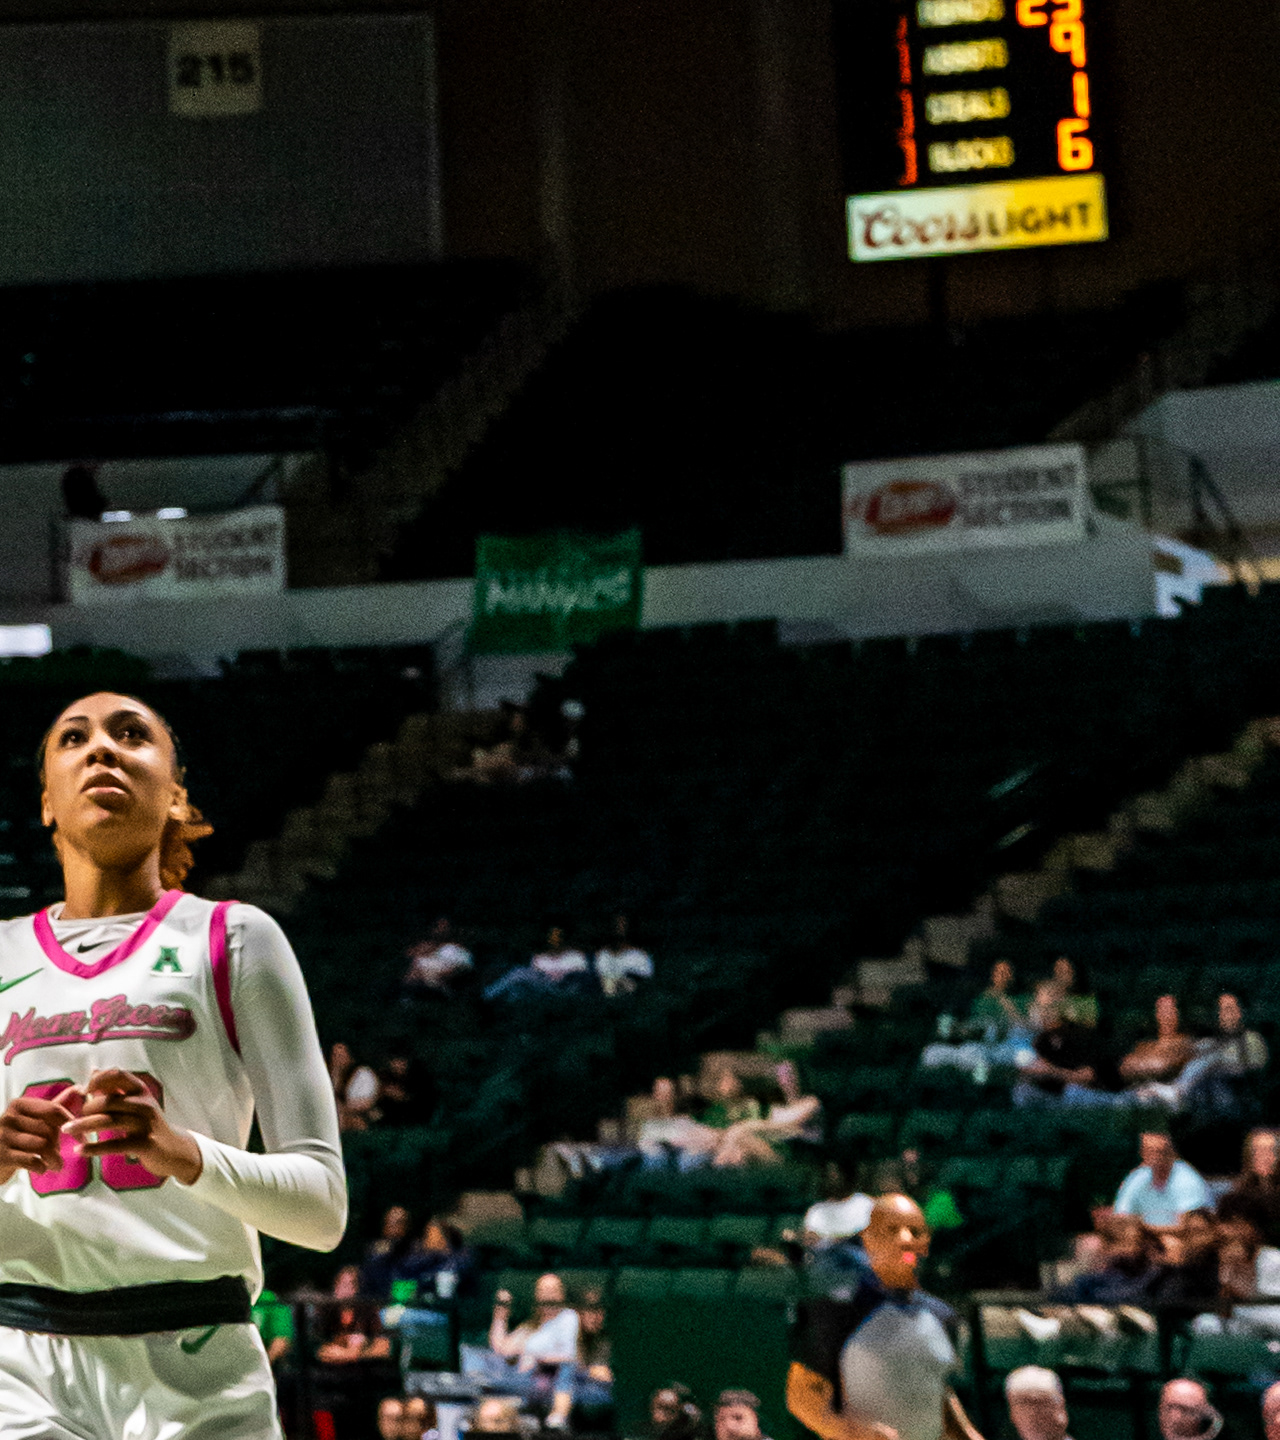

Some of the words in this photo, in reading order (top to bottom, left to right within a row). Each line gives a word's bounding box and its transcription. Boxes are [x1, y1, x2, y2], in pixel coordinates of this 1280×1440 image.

[176, 51, 257, 88] 215
[1055, 117, 1095, 172] 6
[987, 199, 1095, 242] LIGHT
